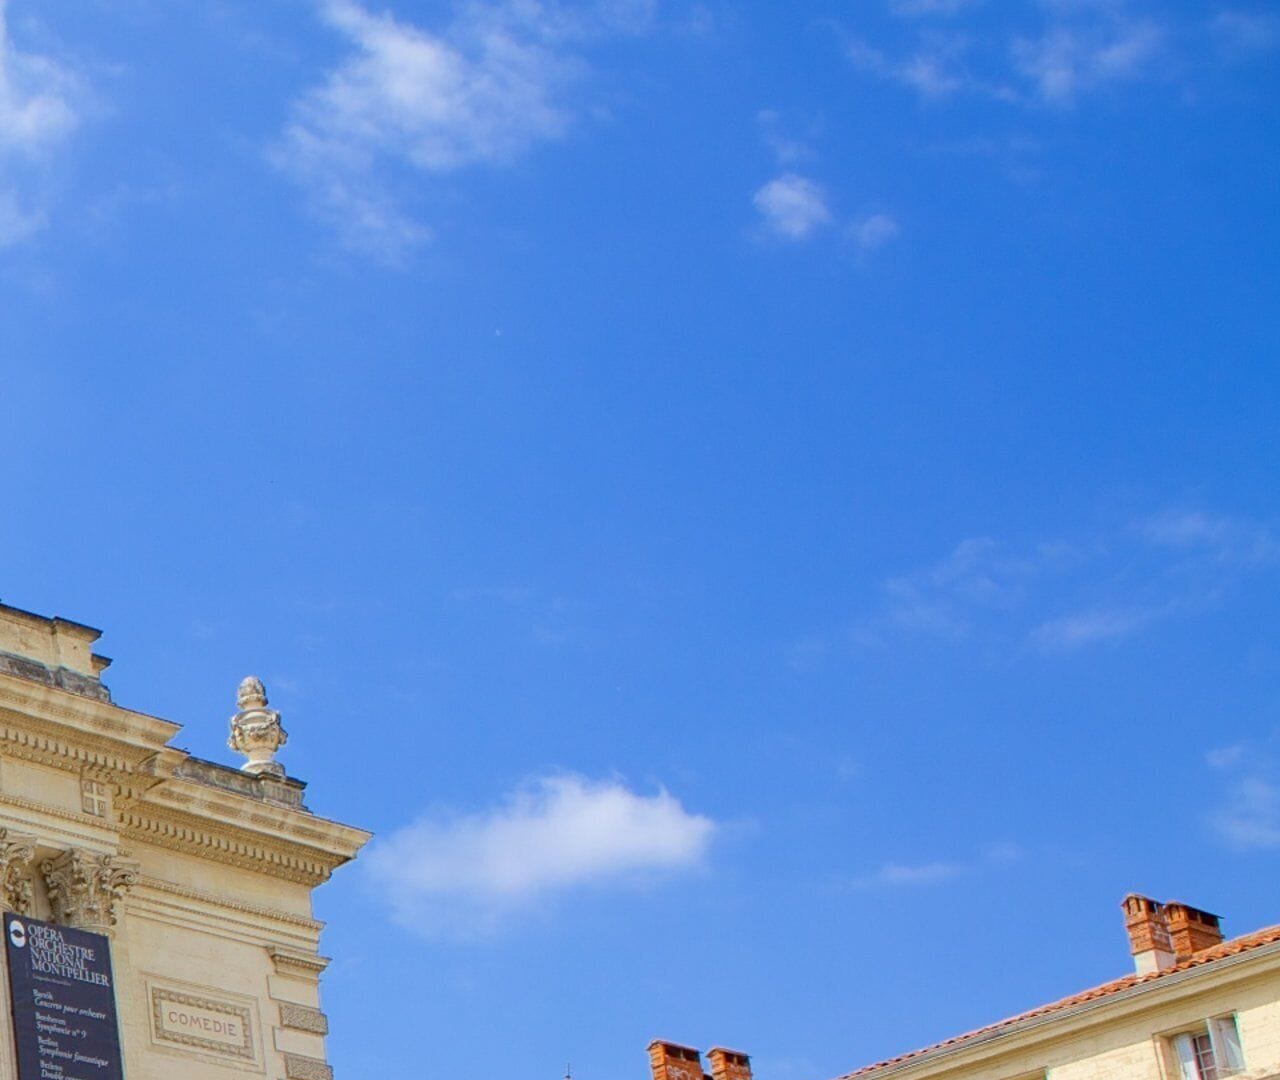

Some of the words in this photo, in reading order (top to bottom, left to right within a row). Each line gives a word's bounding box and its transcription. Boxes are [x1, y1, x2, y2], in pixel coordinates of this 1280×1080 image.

[27, 924, 64, 942] OPÉRA
[29, 936, 95, 961] ORCHESTRE
[30, 947, 87, 970] NATIONAL
[31, 957, 110, 987] MONTPELLIER
[168, 1011, 237, 1037] COMEDIE
